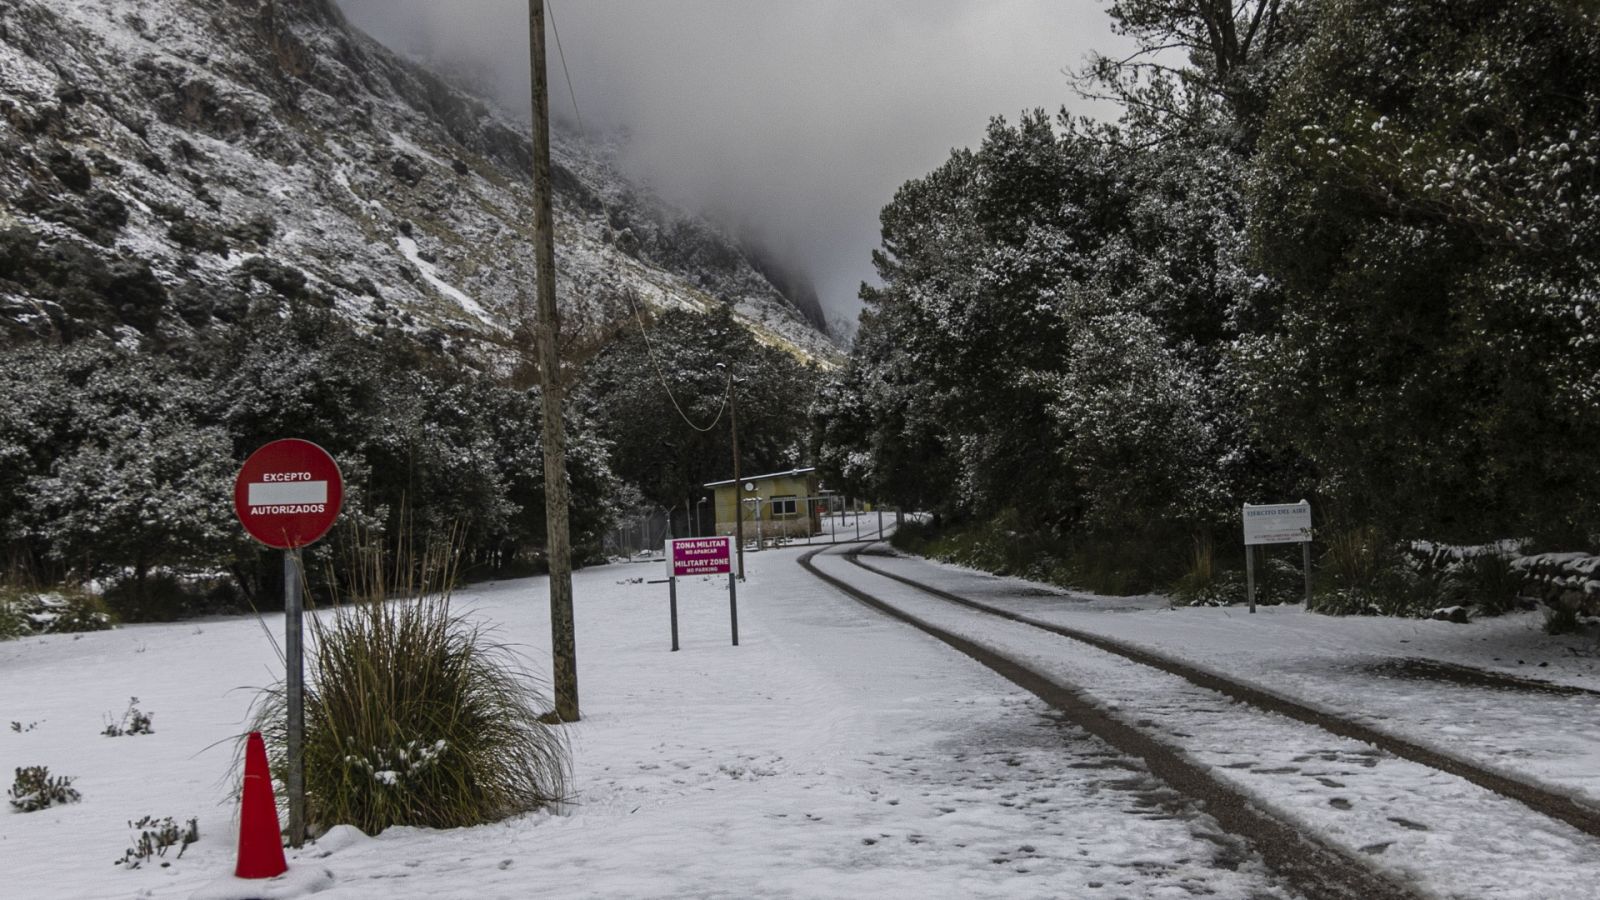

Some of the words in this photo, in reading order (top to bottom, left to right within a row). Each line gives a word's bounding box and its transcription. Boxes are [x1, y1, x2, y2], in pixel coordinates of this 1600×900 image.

[263, 472, 311, 482] EXCEPTO
[250, 504, 325, 515] AUTORIZADOS
[697, 540, 726, 548] MILITAR
